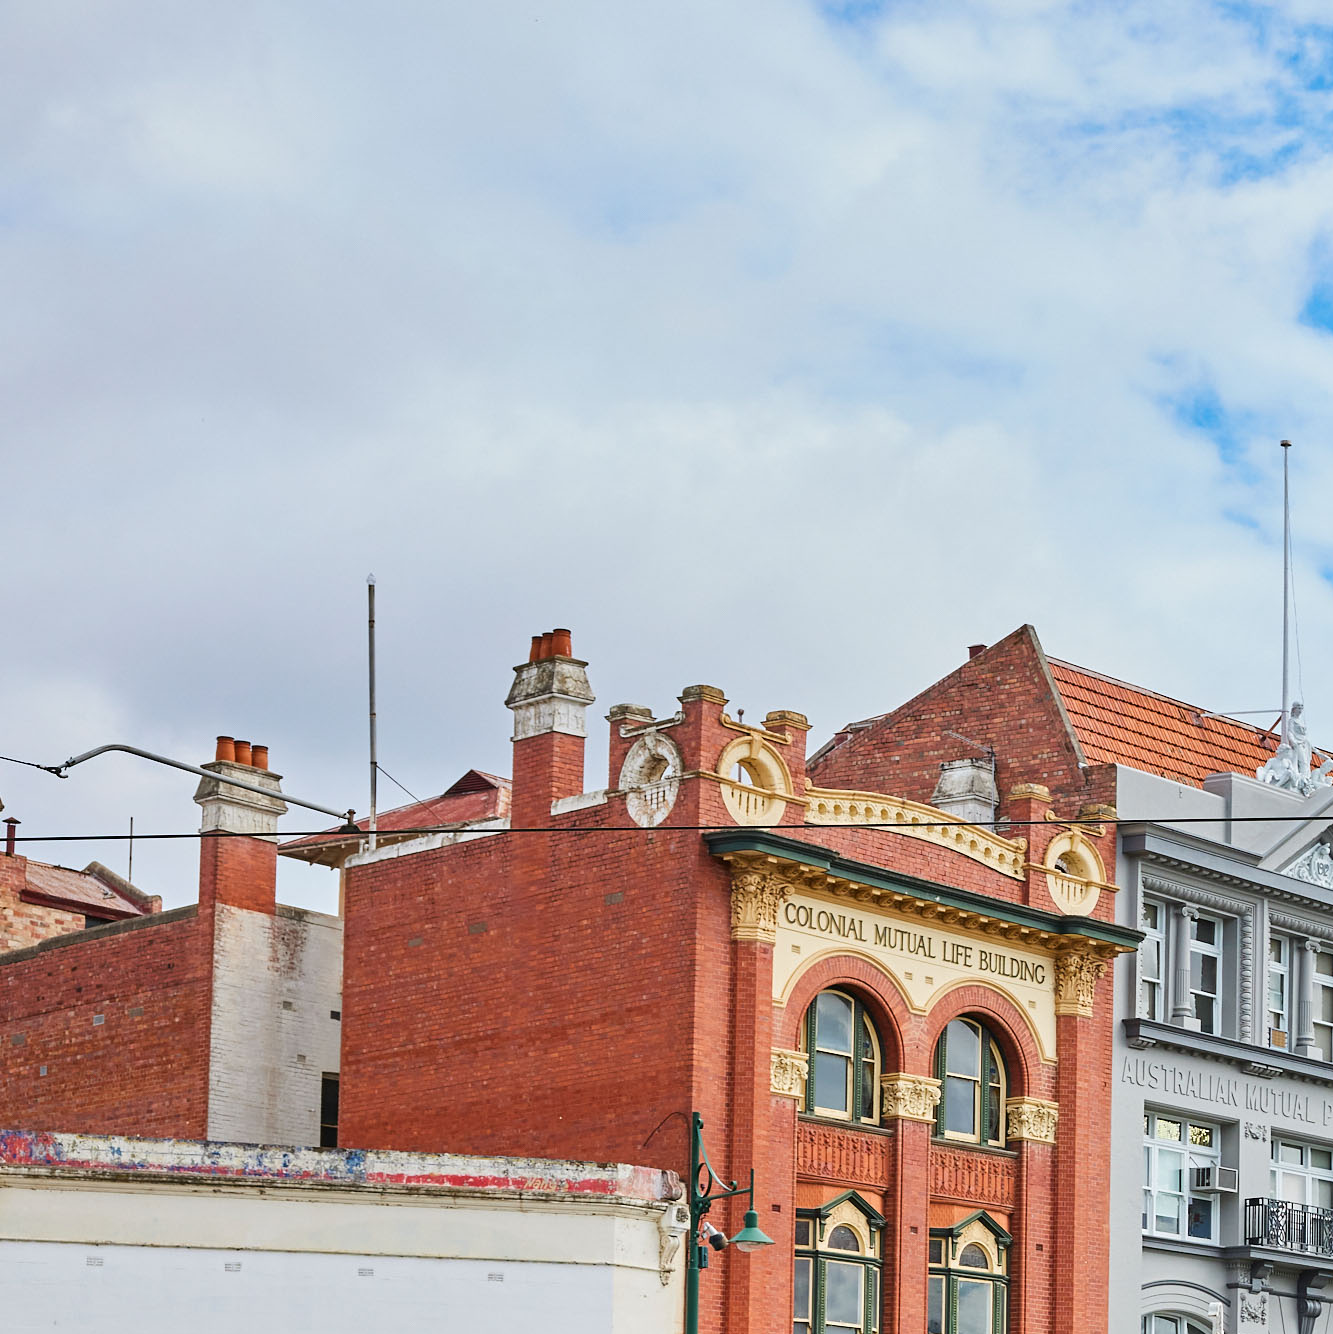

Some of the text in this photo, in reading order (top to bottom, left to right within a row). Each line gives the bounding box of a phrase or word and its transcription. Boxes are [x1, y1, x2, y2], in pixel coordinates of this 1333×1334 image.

[784, 902, 1046, 984] COLONIAL MUTUAL LIFE BUILDING
[1121, 1056, 1238, 1107] AUSTRALIAN
[1245, 1082, 1316, 1124] MUTUAL
